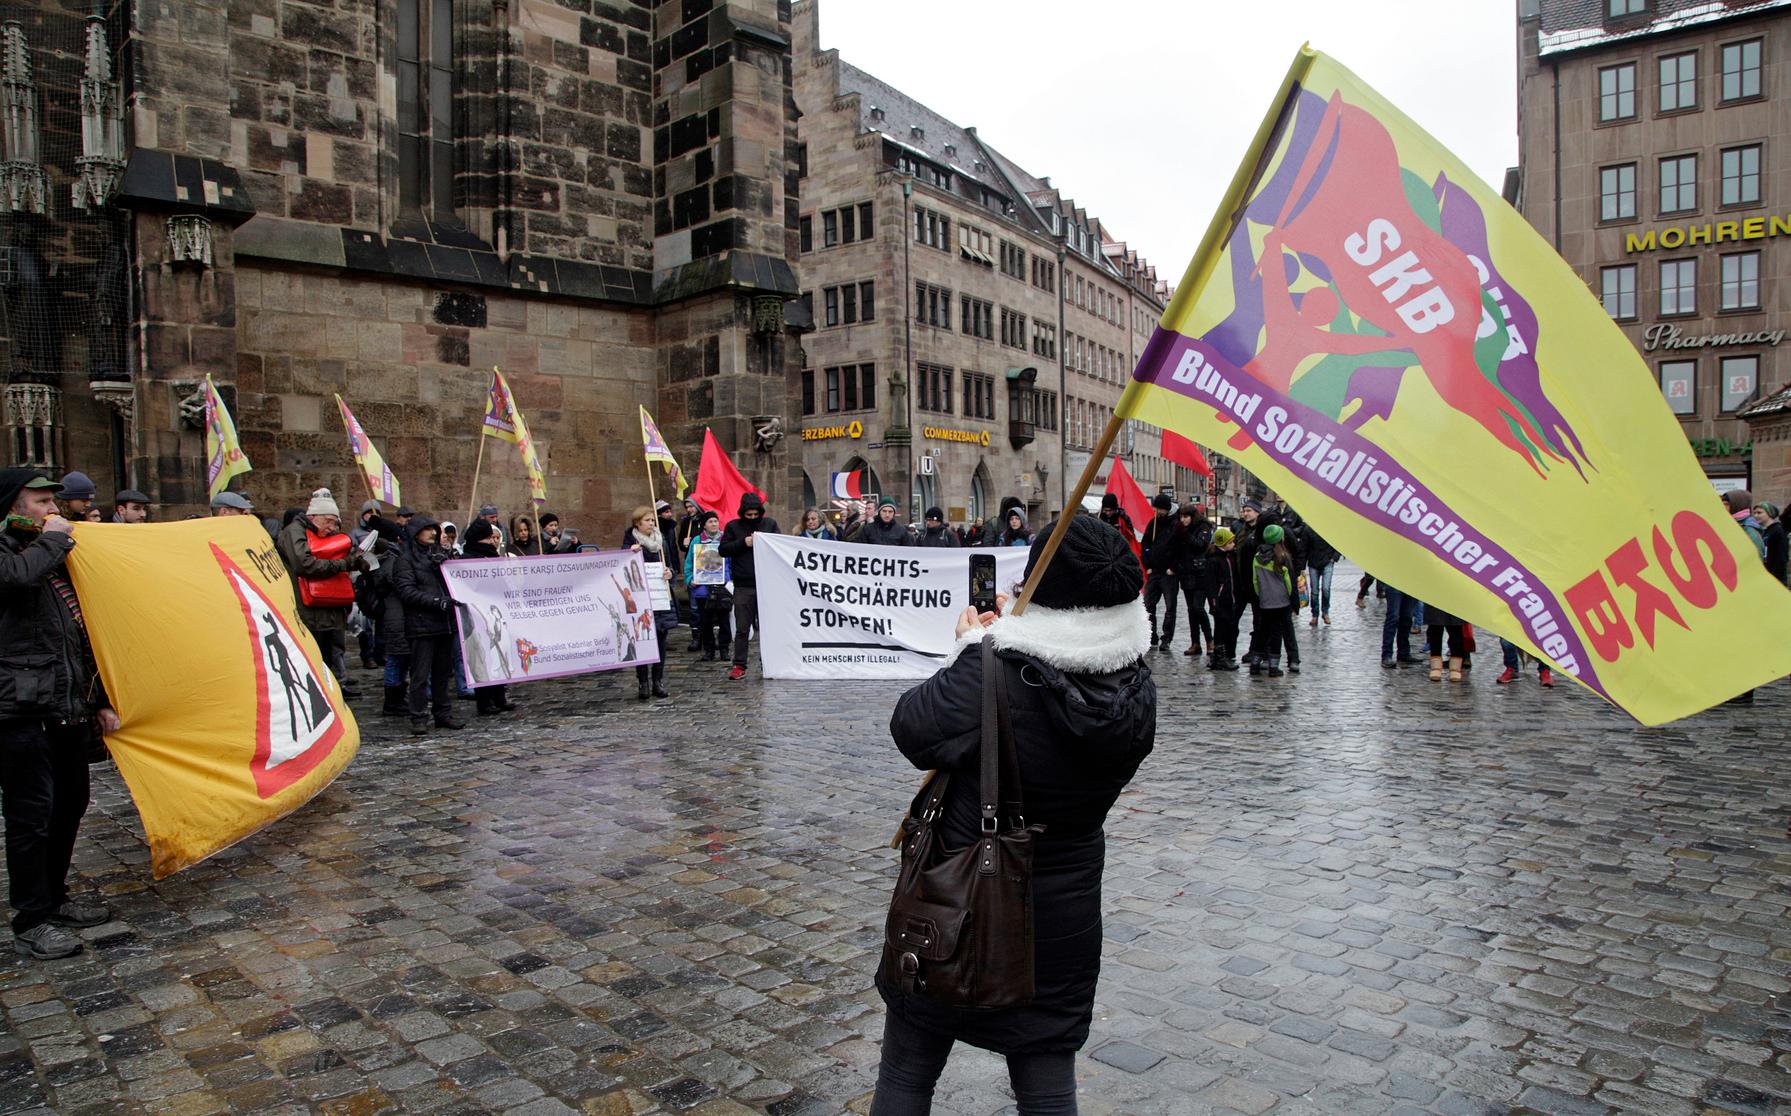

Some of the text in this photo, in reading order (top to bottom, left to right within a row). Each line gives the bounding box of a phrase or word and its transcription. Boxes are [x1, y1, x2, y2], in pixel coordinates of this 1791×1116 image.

[1626, 215, 1791, 253] MOHREN
[1344, 218, 1455, 333] SKB
[1644, 323, 1785, 351] Pharmacy
[924, 426, 980, 443] COMMERZBANK
[924, 458, 933, 473] U
[1171, 348, 1263, 424] Bund
[1256, 406, 1499, 573] Sozialistischer
[1491, 567, 1580, 676] Frauen
[793, 550, 929, 578] ASYLRECHTS-
[503, 585, 573, 599] WIR SIND FRAUEN!
[797, 578, 952, 608] VERSCHÄRFUNG
[1563, 510, 1738, 662] SKB
[505, 594, 591, 610] WIR VERTEIDIGEN UNS
[509, 604, 599, 620] SELBER GEGEN GEWALT!
[800, 608, 893, 636] STOPPEN!
[533, 648, 615, 664] Bund Sozialistischer Frauen
[802, 655, 900, 664] KEIN MENSCH IST ILLEGAL!
